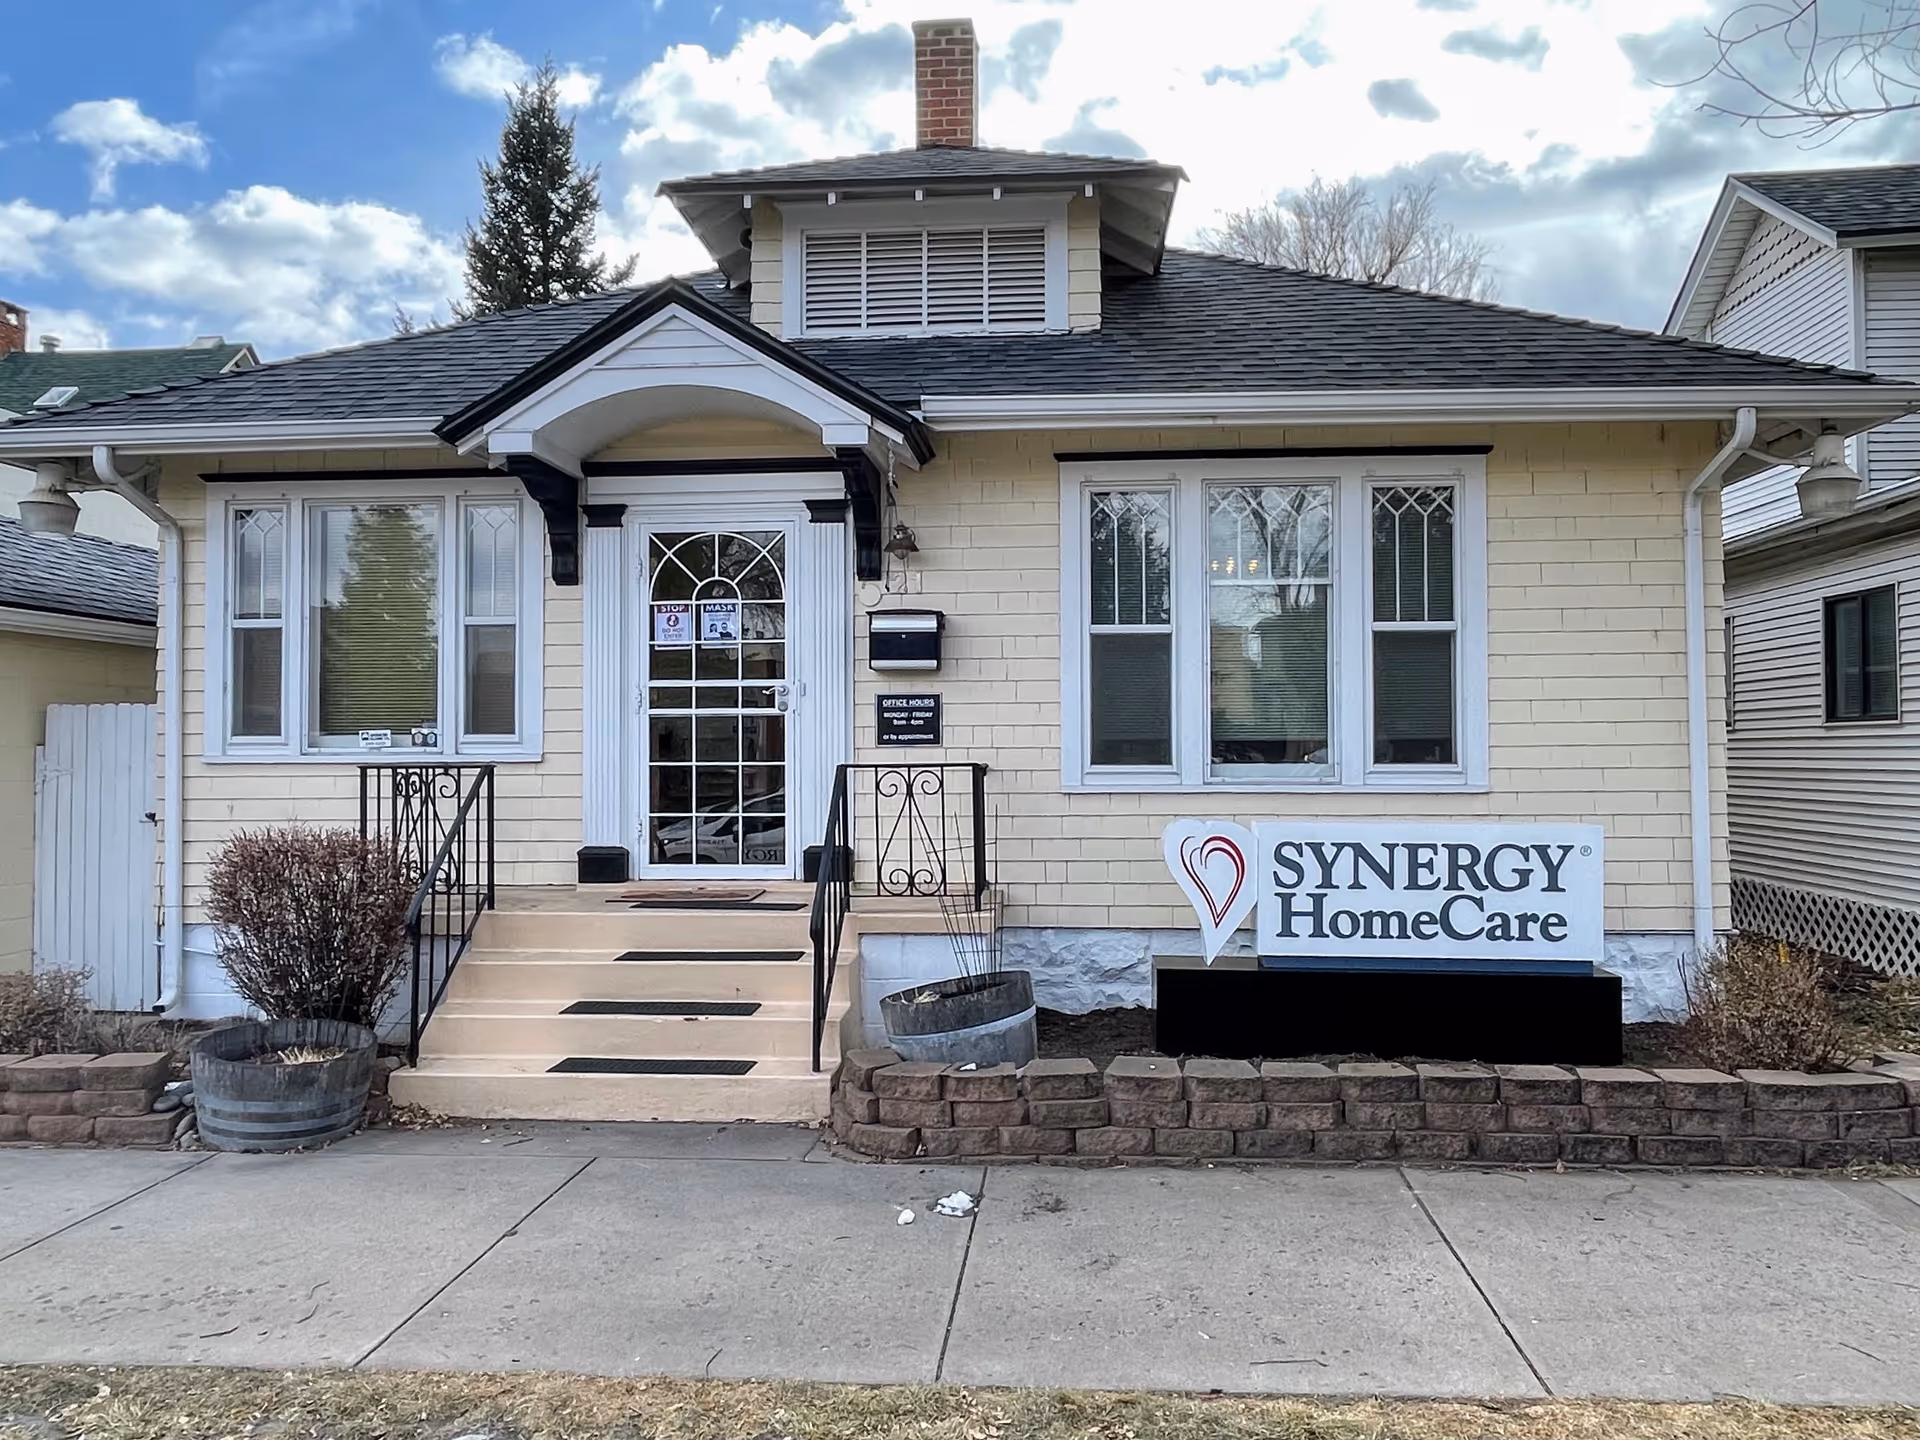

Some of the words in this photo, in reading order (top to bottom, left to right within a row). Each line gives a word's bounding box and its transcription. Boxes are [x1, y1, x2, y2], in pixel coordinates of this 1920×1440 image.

[706, 604, 734, 612] MASK
[883, 699, 908, 707] OFFICE
[909, 699, 934, 707] HOURS
[1273, 893, 1568, 942] HomeCare
